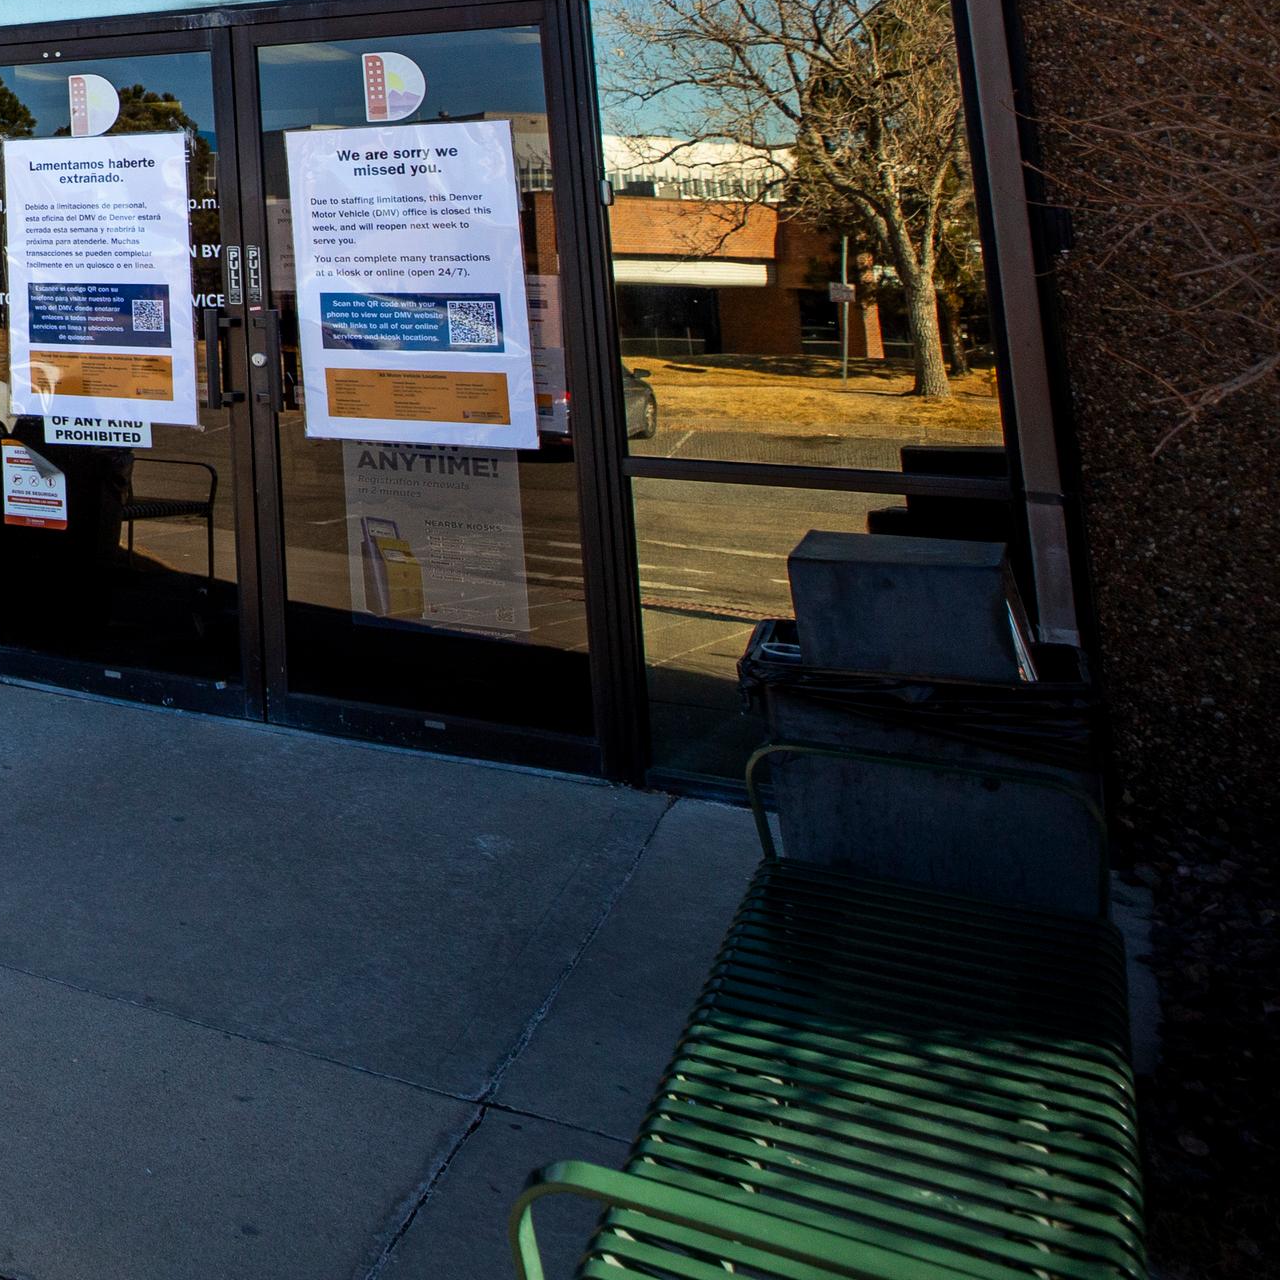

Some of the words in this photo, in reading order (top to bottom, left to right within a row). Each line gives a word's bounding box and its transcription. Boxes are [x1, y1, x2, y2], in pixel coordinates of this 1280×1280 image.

[336, 150, 360, 162] We
[365, 150, 388, 160] are
[393, 148, 430, 160] sorry
[436, 146, 458, 157] we
[29, 160, 104, 171] Lamentamos
[108, 157, 155, 169] haberte
[354, 163, 405, 177] missed
[410, 164, 442, 176] you.
[59, 173, 124, 184] extrañado.
[341, 196, 374, 205] staffing
[376, 195, 426, 203] limitations,
[429, 194, 446, 202] this
[449, 193, 483, 201] Denver
[56, 202, 99, 210] limitaciones
[188, 197, 220, 214] p.m.
[338, 210, 370, 218] Vehicle
[372, 209, 400, 218] (DMV)
[402, 208, 428, 216] office
[440, 207, 470, 215] closed
[474, 206, 492, 214] this
[312, 224, 338, 232] week,
[340, 223, 356, 231] and
[359, 222, 373, 230] will
[376, 222, 407, 231] reopen
[410, 222, 430, 230] next
[432, 221, 457, 229] week
[338, 238, 356, 246] you.
[86, 250, 112, 258] pueden
[201, 244, 222, 259] BY
[314, 255, 332, 263] You
[354, 254, 397, 264] complete
[400, 254, 426, 264] many
[430, 253, 491, 262] transactions
[86, 262, 115, 270] quiosco
[228, 250, 240, 289] PULL
[248, 250, 260, 288] PULL
[336, 268, 360, 276] kiosk
[376, 268, 405, 276] online
[408, 268, 435, 278] (open
[438, 268, 470, 278] 24/7).
[366, 300, 379, 308] QR
[380, 300, 399, 308] code
[400, 300, 417, 308] with
[402, 334, 439, 342] locations.
[52, 416, 69, 426] OF
[74, 417, 102, 427] ANY
[108, 419, 143, 428] KIND
[55, 430, 142, 443] PROHIBITED
[357, 450, 499, 478] ANYTIME!
[357, 474, 420, 488] Registration
[422, 480, 470, 490] renewals
[380, 488, 422, 498] minutes
[424, 520, 464, 529] NEARBY
[466, 522, 502, 532] KIOSKS
